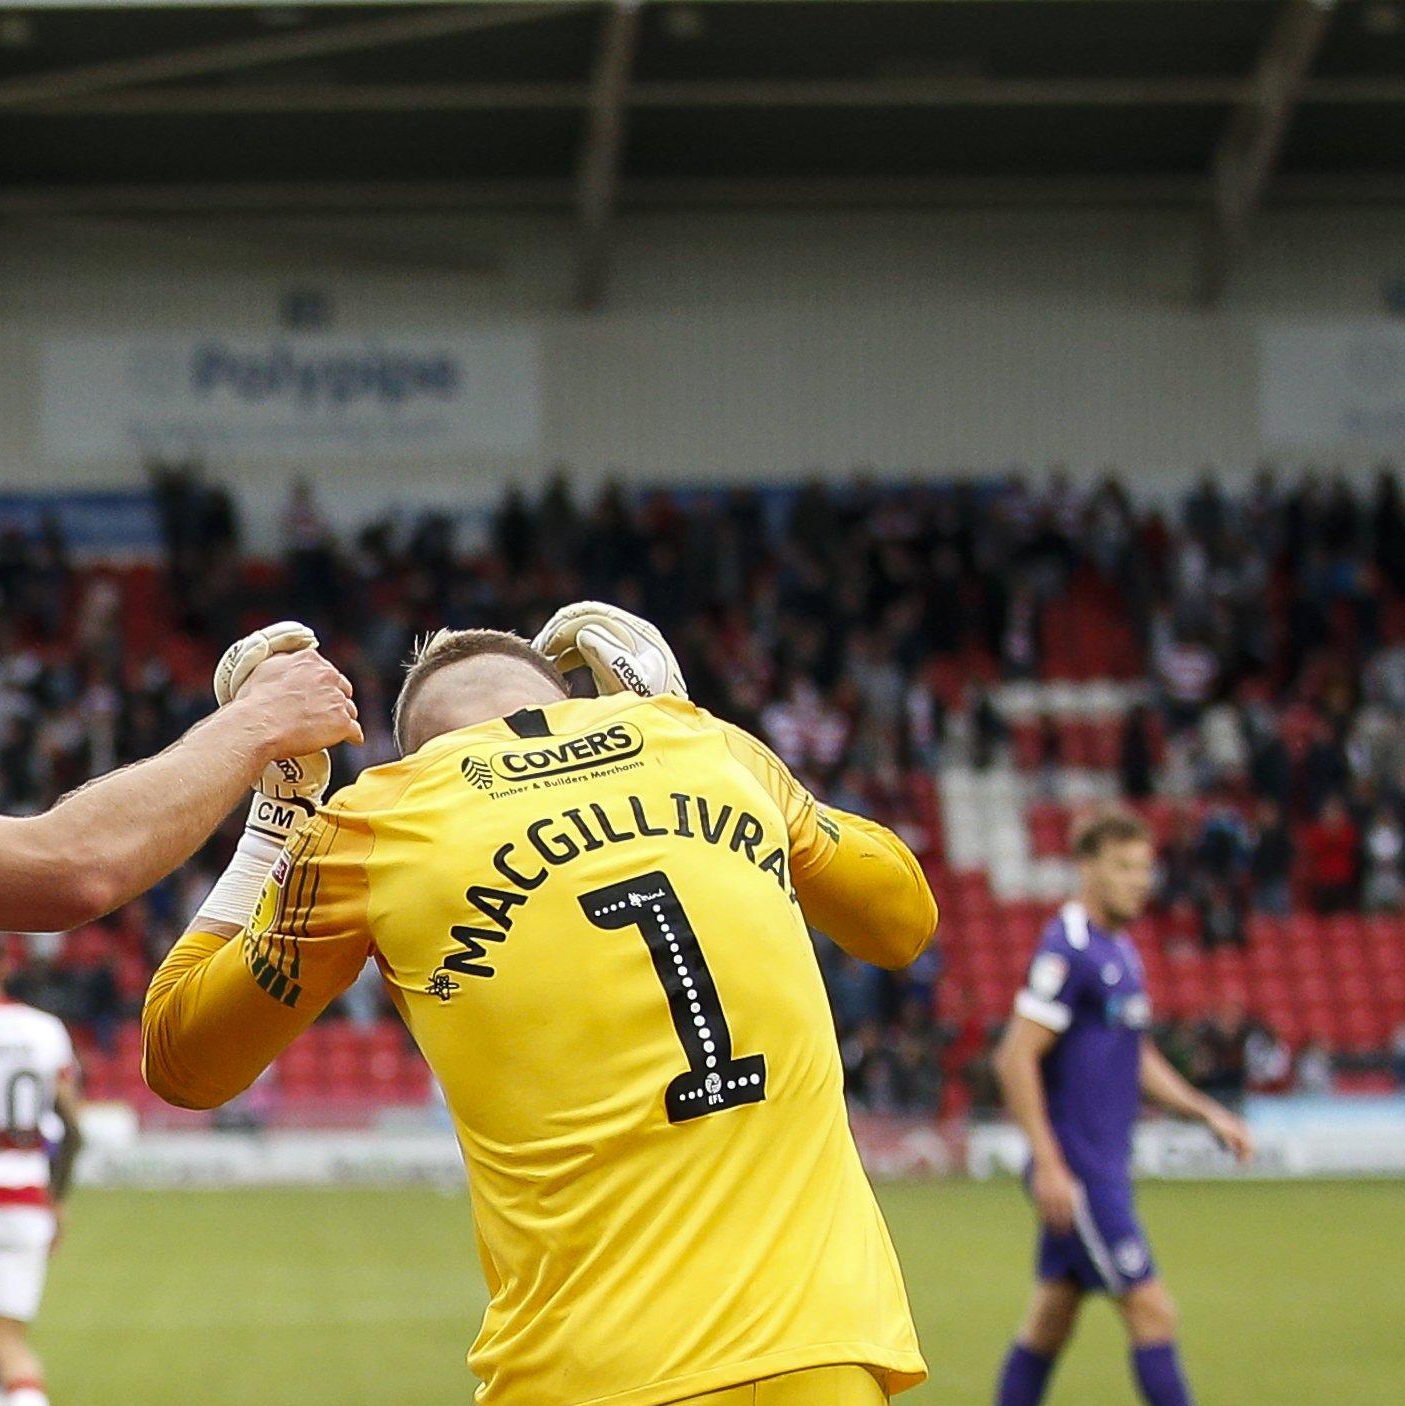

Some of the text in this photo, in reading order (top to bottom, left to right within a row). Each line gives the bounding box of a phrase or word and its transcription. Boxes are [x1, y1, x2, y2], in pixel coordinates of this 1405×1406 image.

[502, 725, 633, 773] COVERS
[488, 760, 645, 801] Timber & Builders Merchants
[257, 801, 295, 829] CM
[443, 793, 799, 978] MACGILLIVRA
[577, 870, 767, 1124] 1
[708, 1093, 724, 1105] EFL
